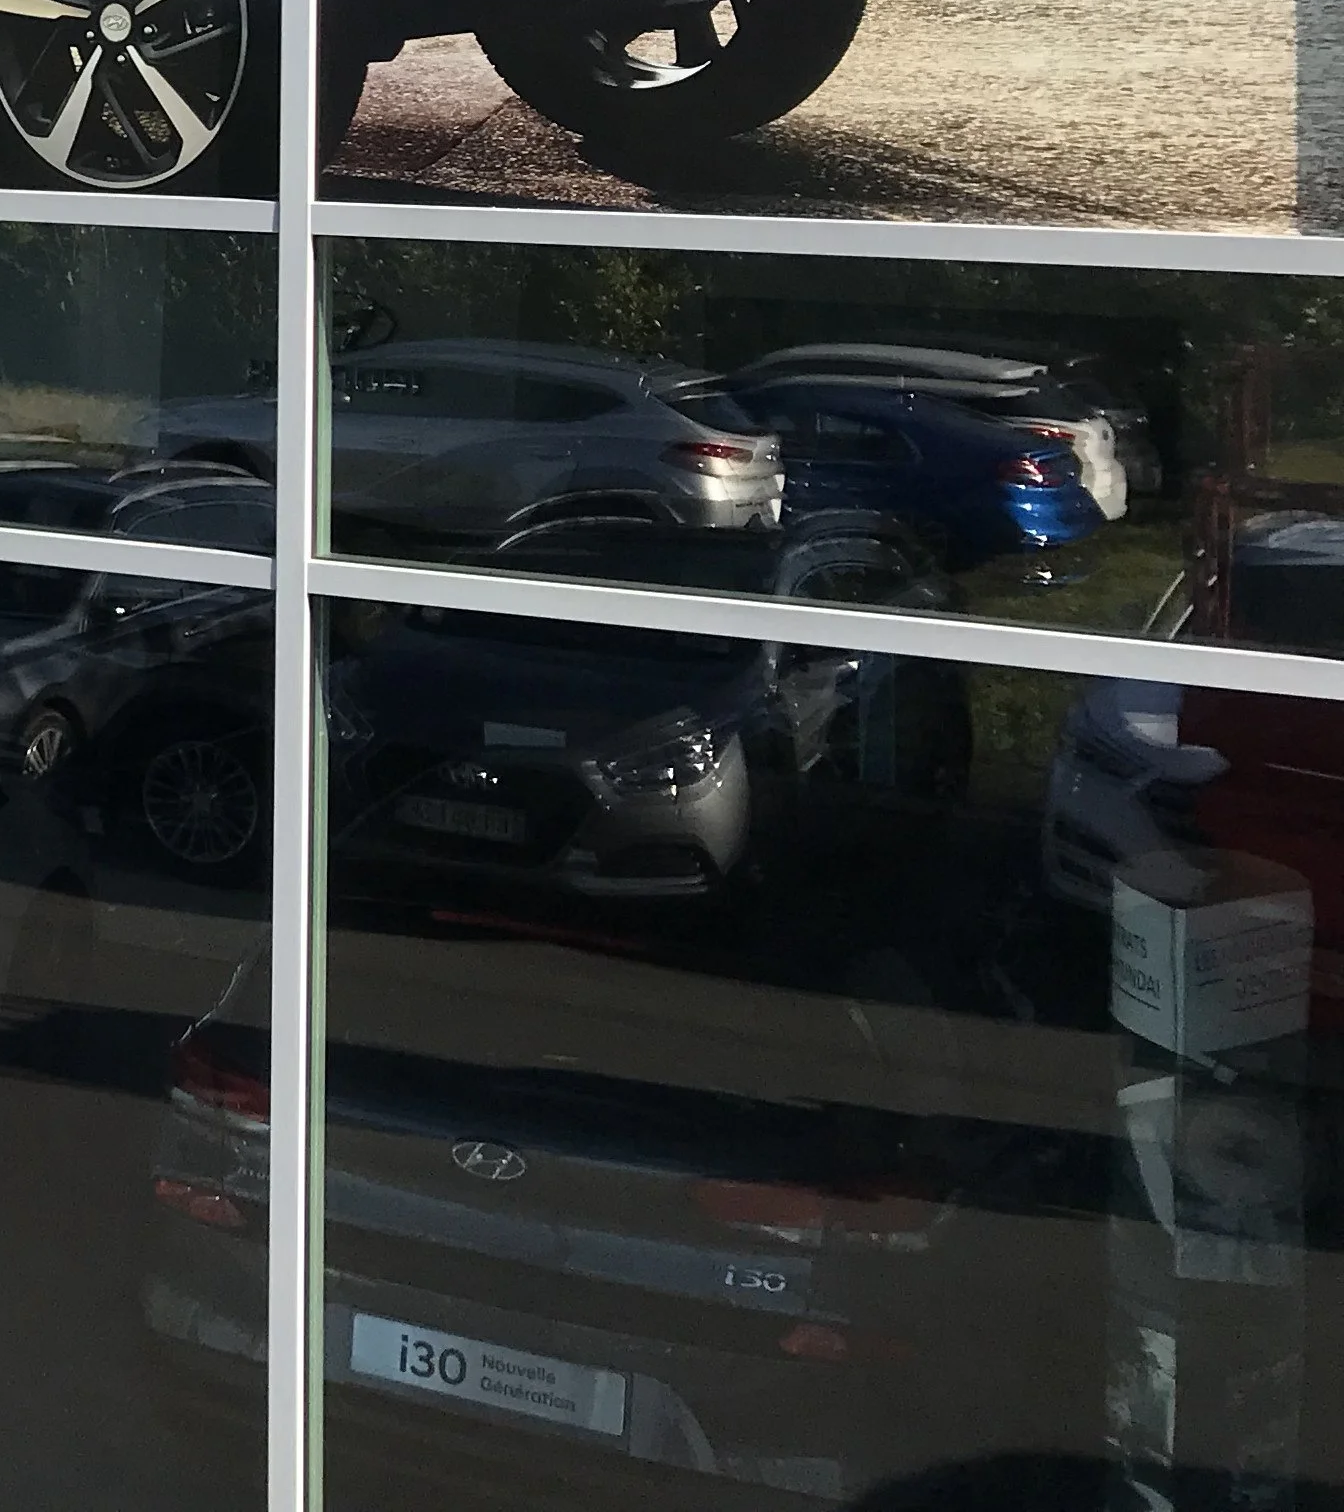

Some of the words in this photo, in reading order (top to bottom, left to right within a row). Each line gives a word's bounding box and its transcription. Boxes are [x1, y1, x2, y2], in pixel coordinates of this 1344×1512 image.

[723, 1262, 788, 1293] i30
[398, 1333, 468, 1387] i30
[481, 1353, 557, 1386] Nouvelle
